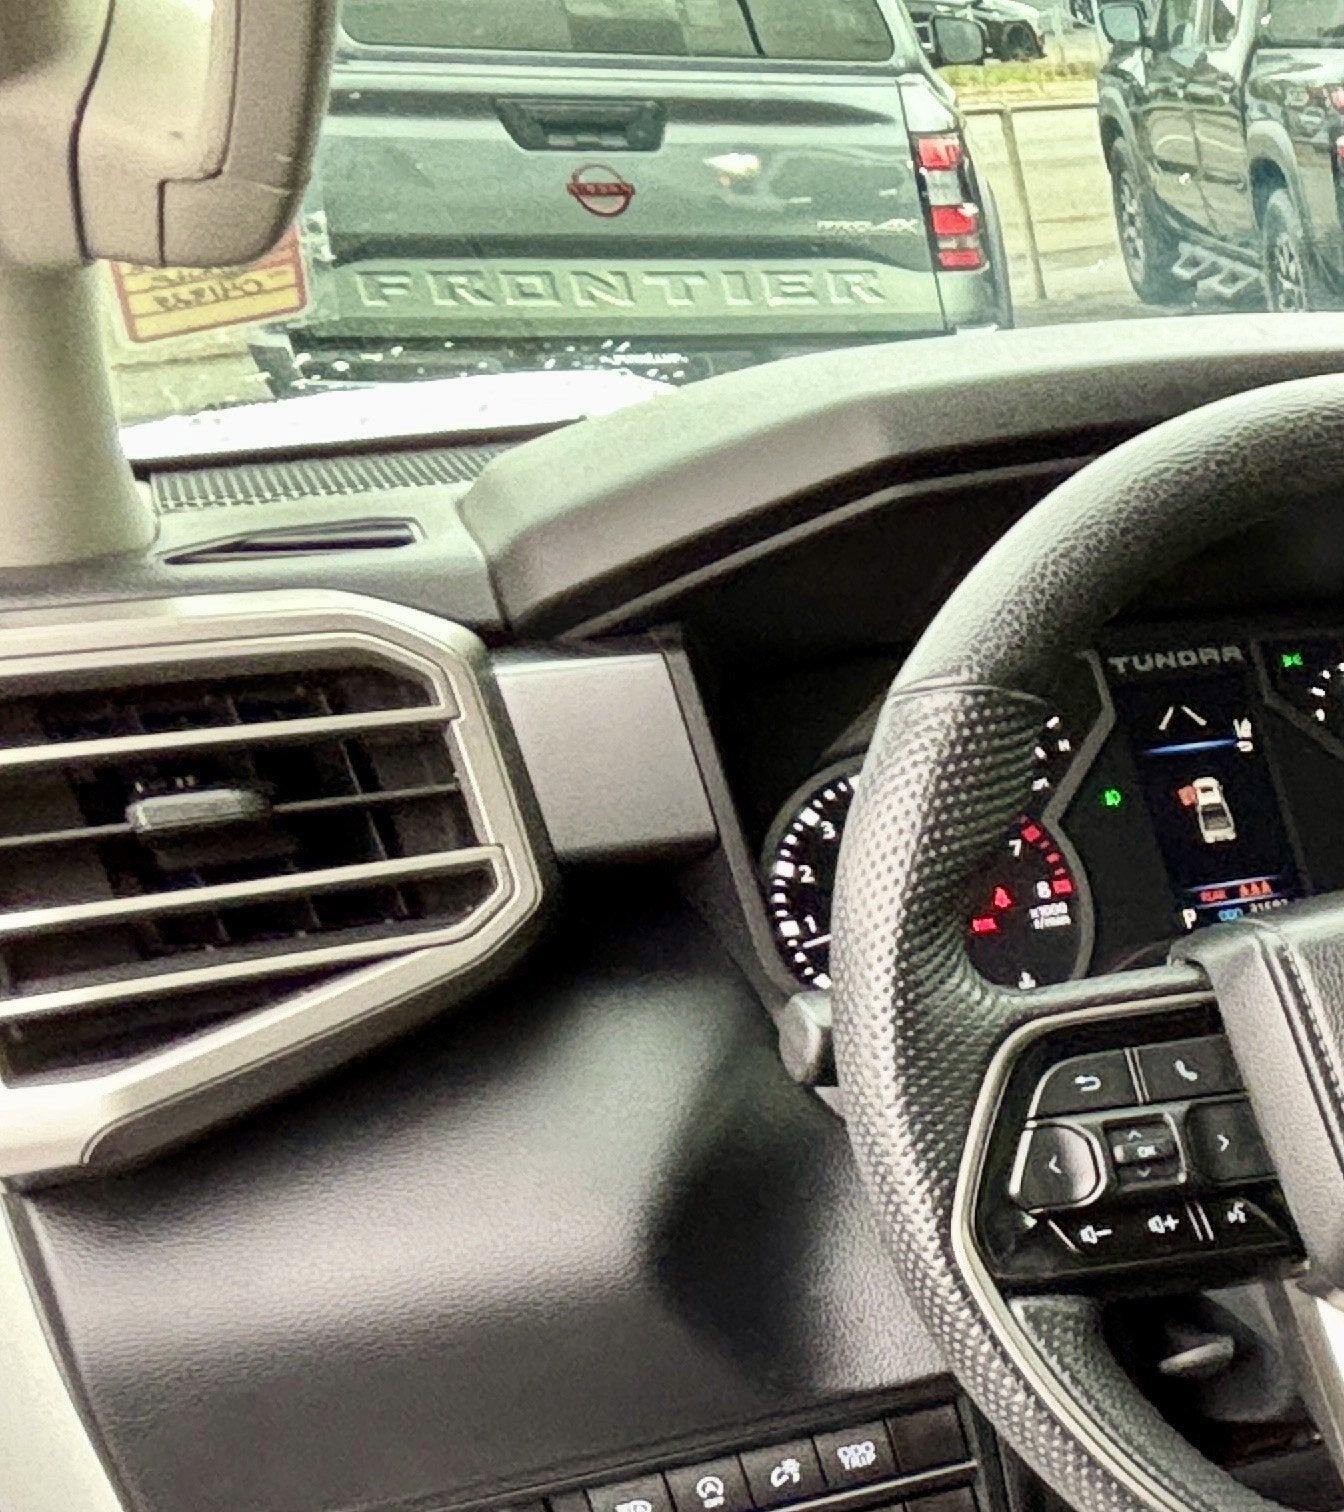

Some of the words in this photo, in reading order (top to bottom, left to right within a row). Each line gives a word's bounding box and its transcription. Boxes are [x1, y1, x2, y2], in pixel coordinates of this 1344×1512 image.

[355, 268, 883, 309] FRONTIER
[1108, 646, 1244, 673] TUNDRA
[818, 820, 836, 839] 3
[1008, 838, 1022, 858] 7
[798, 864, 816, 883] 2
[1036, 880, 1052, 899] 8
[804, 915, 817, 934] 1
[1182, 908, 1198, 929] P
